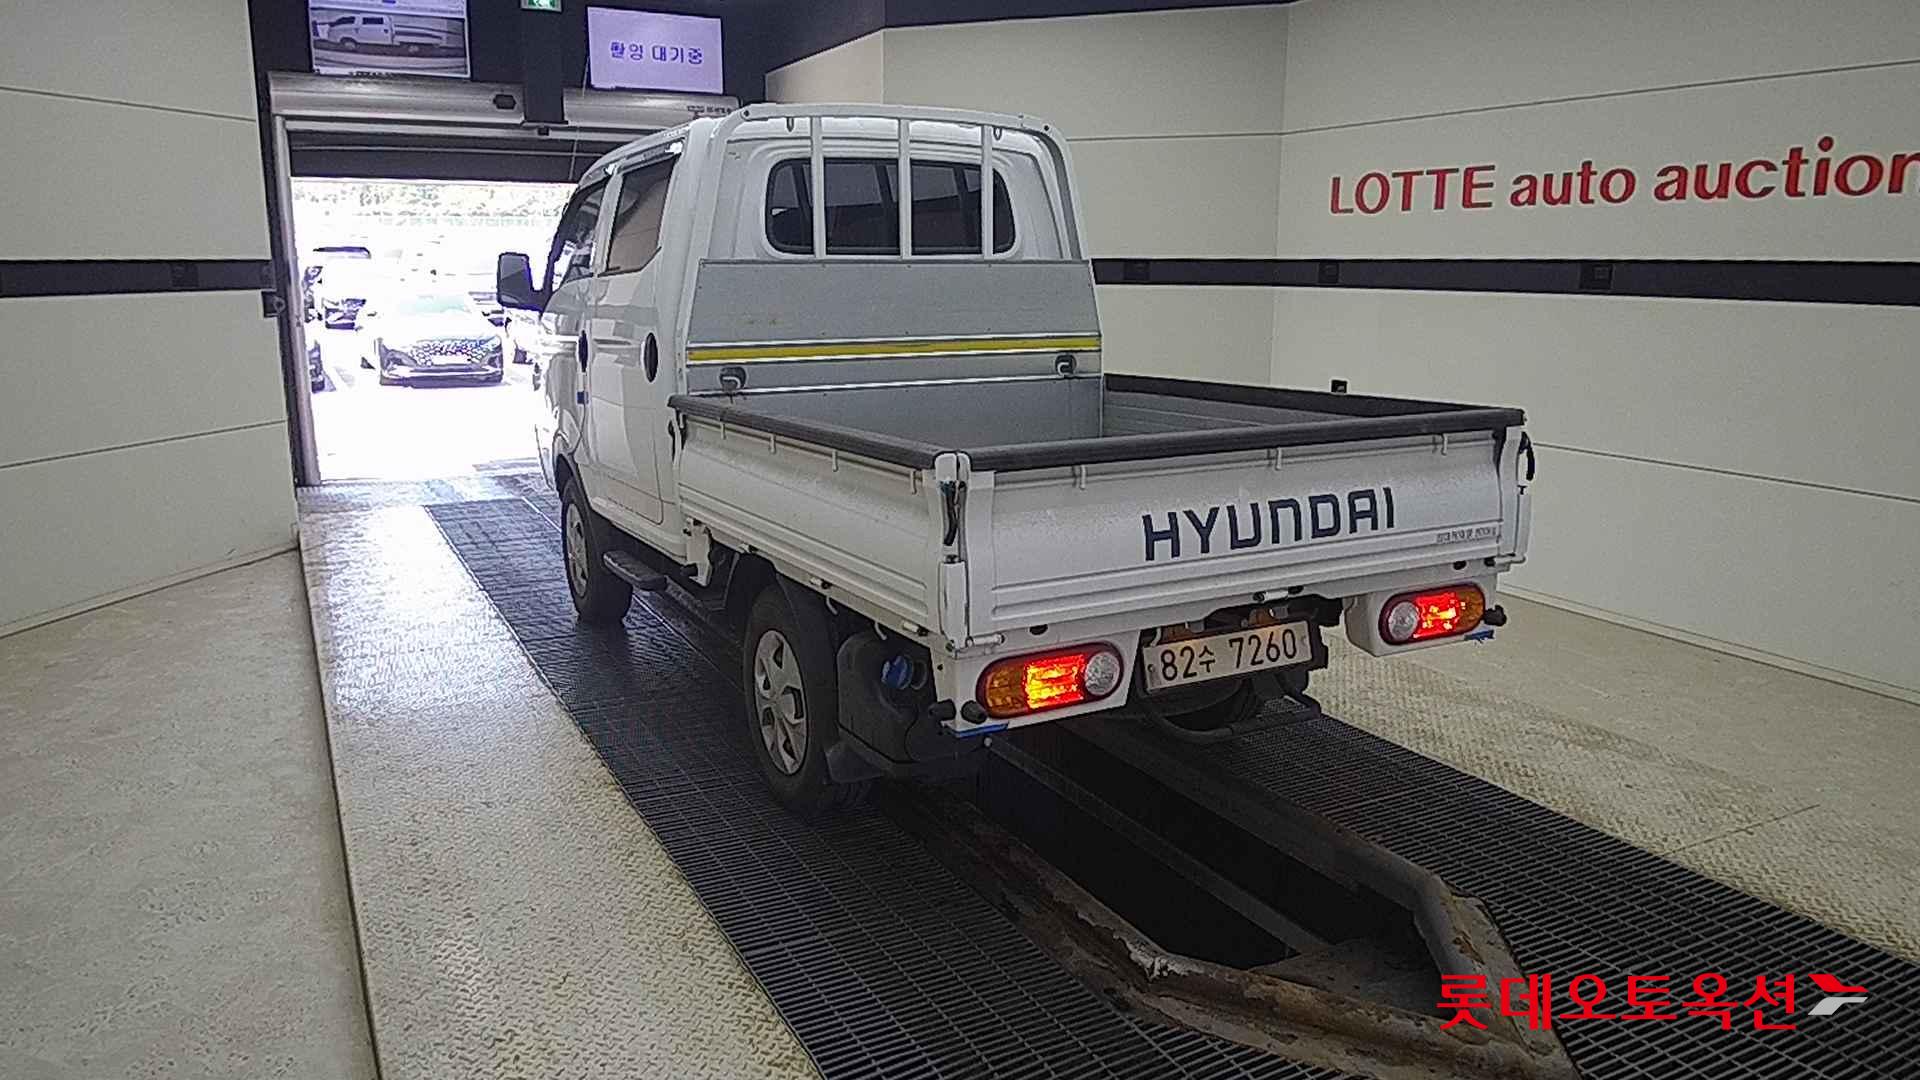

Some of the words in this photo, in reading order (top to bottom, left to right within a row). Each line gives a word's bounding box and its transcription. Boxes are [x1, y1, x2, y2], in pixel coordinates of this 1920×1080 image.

[1331, 165, 1496, 215] LOTTE
[1510, 161, 1636, 207] auto
[1654, 136, 1920, 201] auction
[1142, 487, 1396, 561] HYUNDAI
[1160, 646, 1216, 681] 82수
[1229, 629, 1297, 669] 7260
